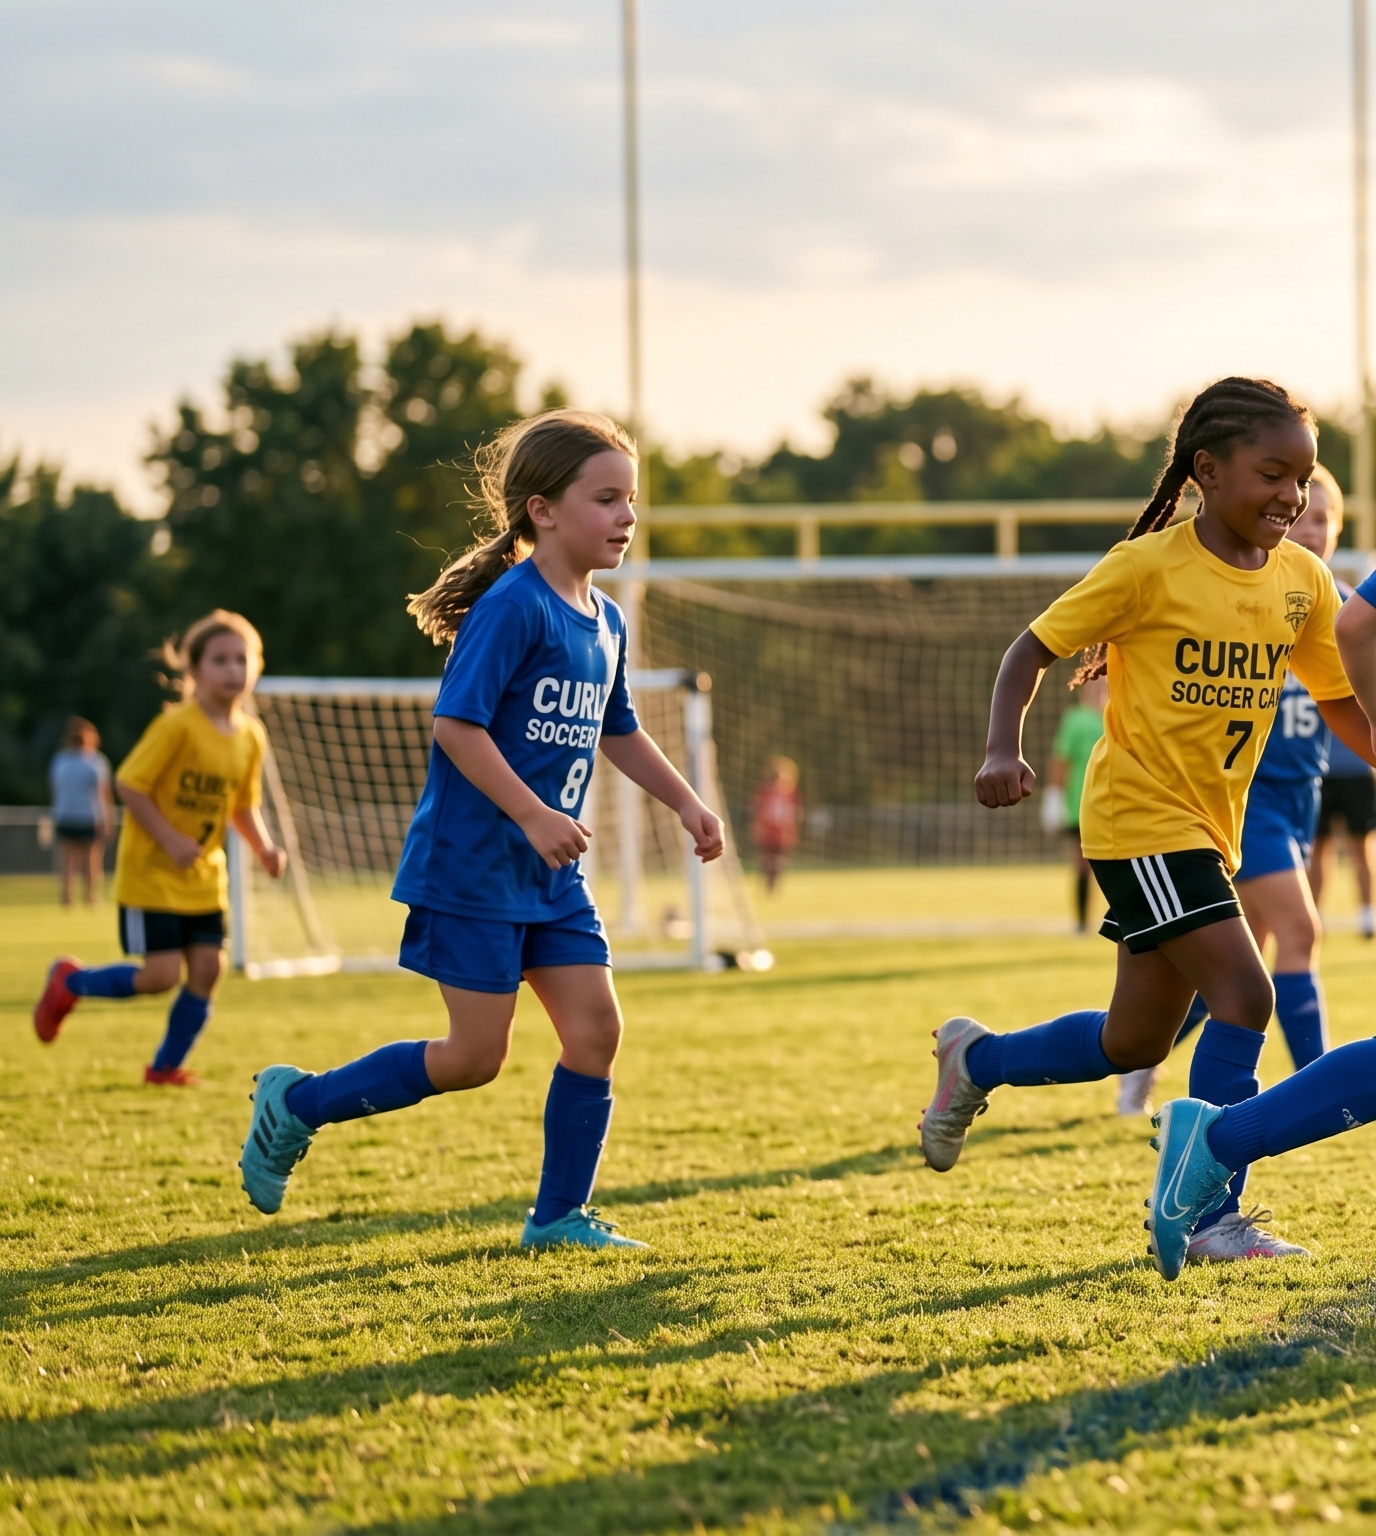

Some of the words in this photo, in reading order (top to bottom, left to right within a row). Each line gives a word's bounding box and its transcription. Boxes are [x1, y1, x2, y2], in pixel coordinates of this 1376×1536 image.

[1171, 680, 1254, 709] SOCCER
[1280, 694, 1319, 739] 15
[525, 718, 596, 749] SOCCER
[1223, 720, 1254, 770] 7
[559, 758, 588, 809] 8
